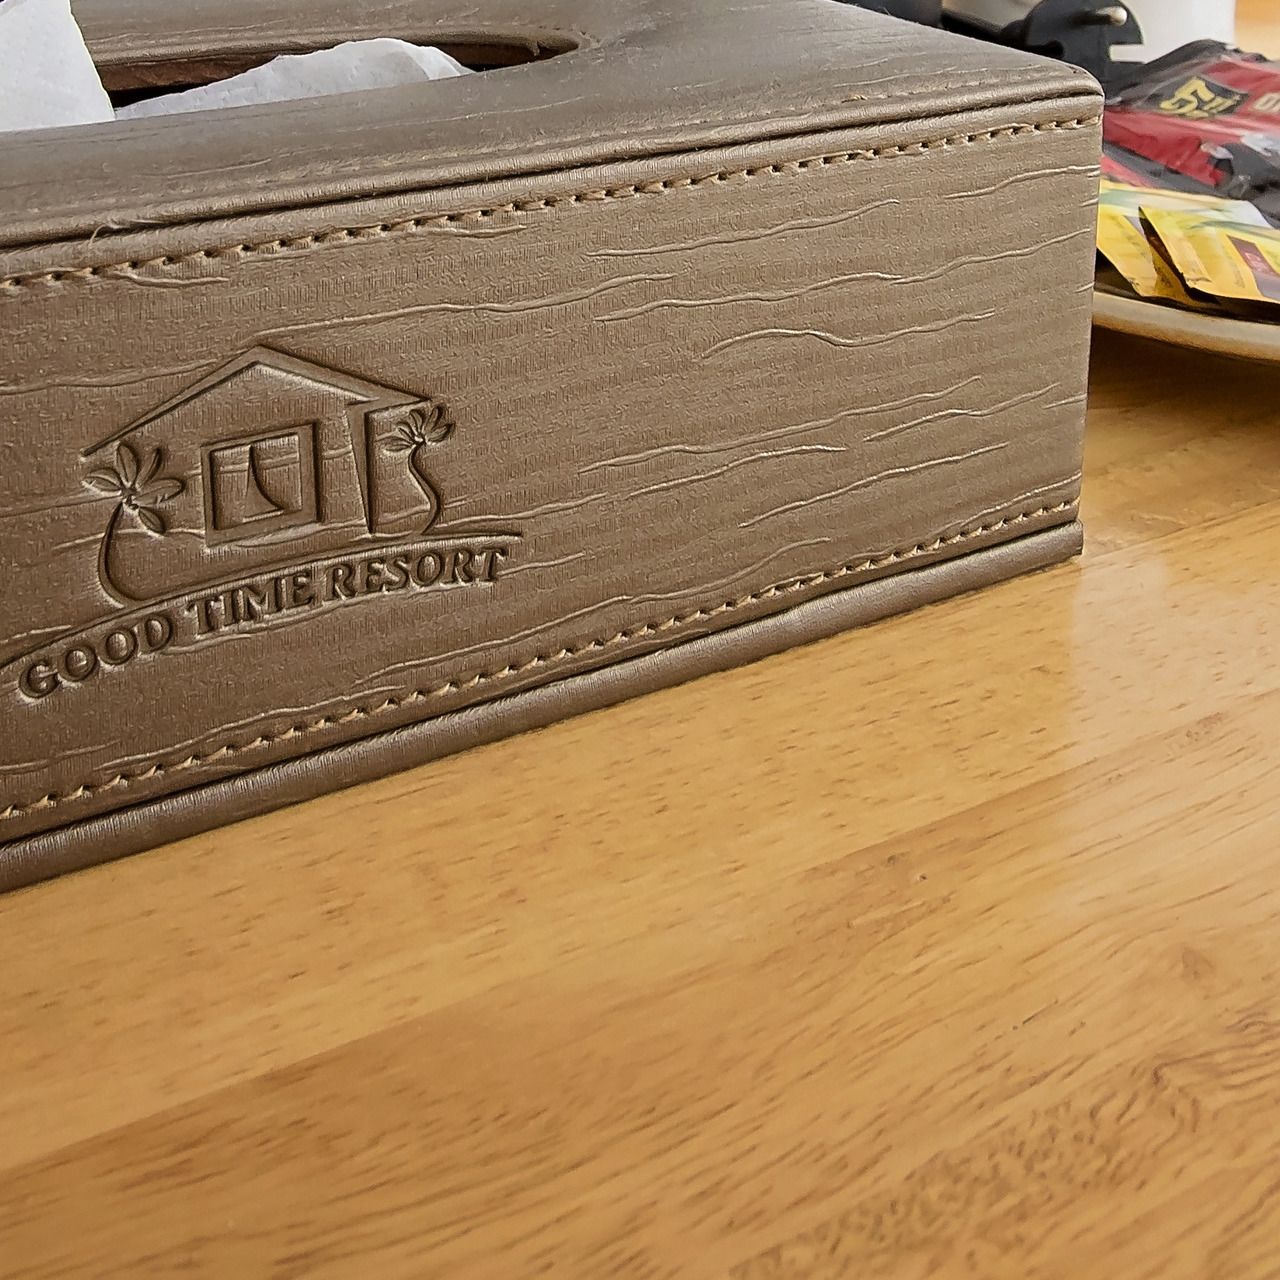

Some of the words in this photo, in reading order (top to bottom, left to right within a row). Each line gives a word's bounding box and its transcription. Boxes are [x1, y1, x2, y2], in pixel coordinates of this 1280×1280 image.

[18, 614, 175, 699] GOOD
[187, 567, 316, 635] TIME
[325, 548, 507, 602] RESORT
